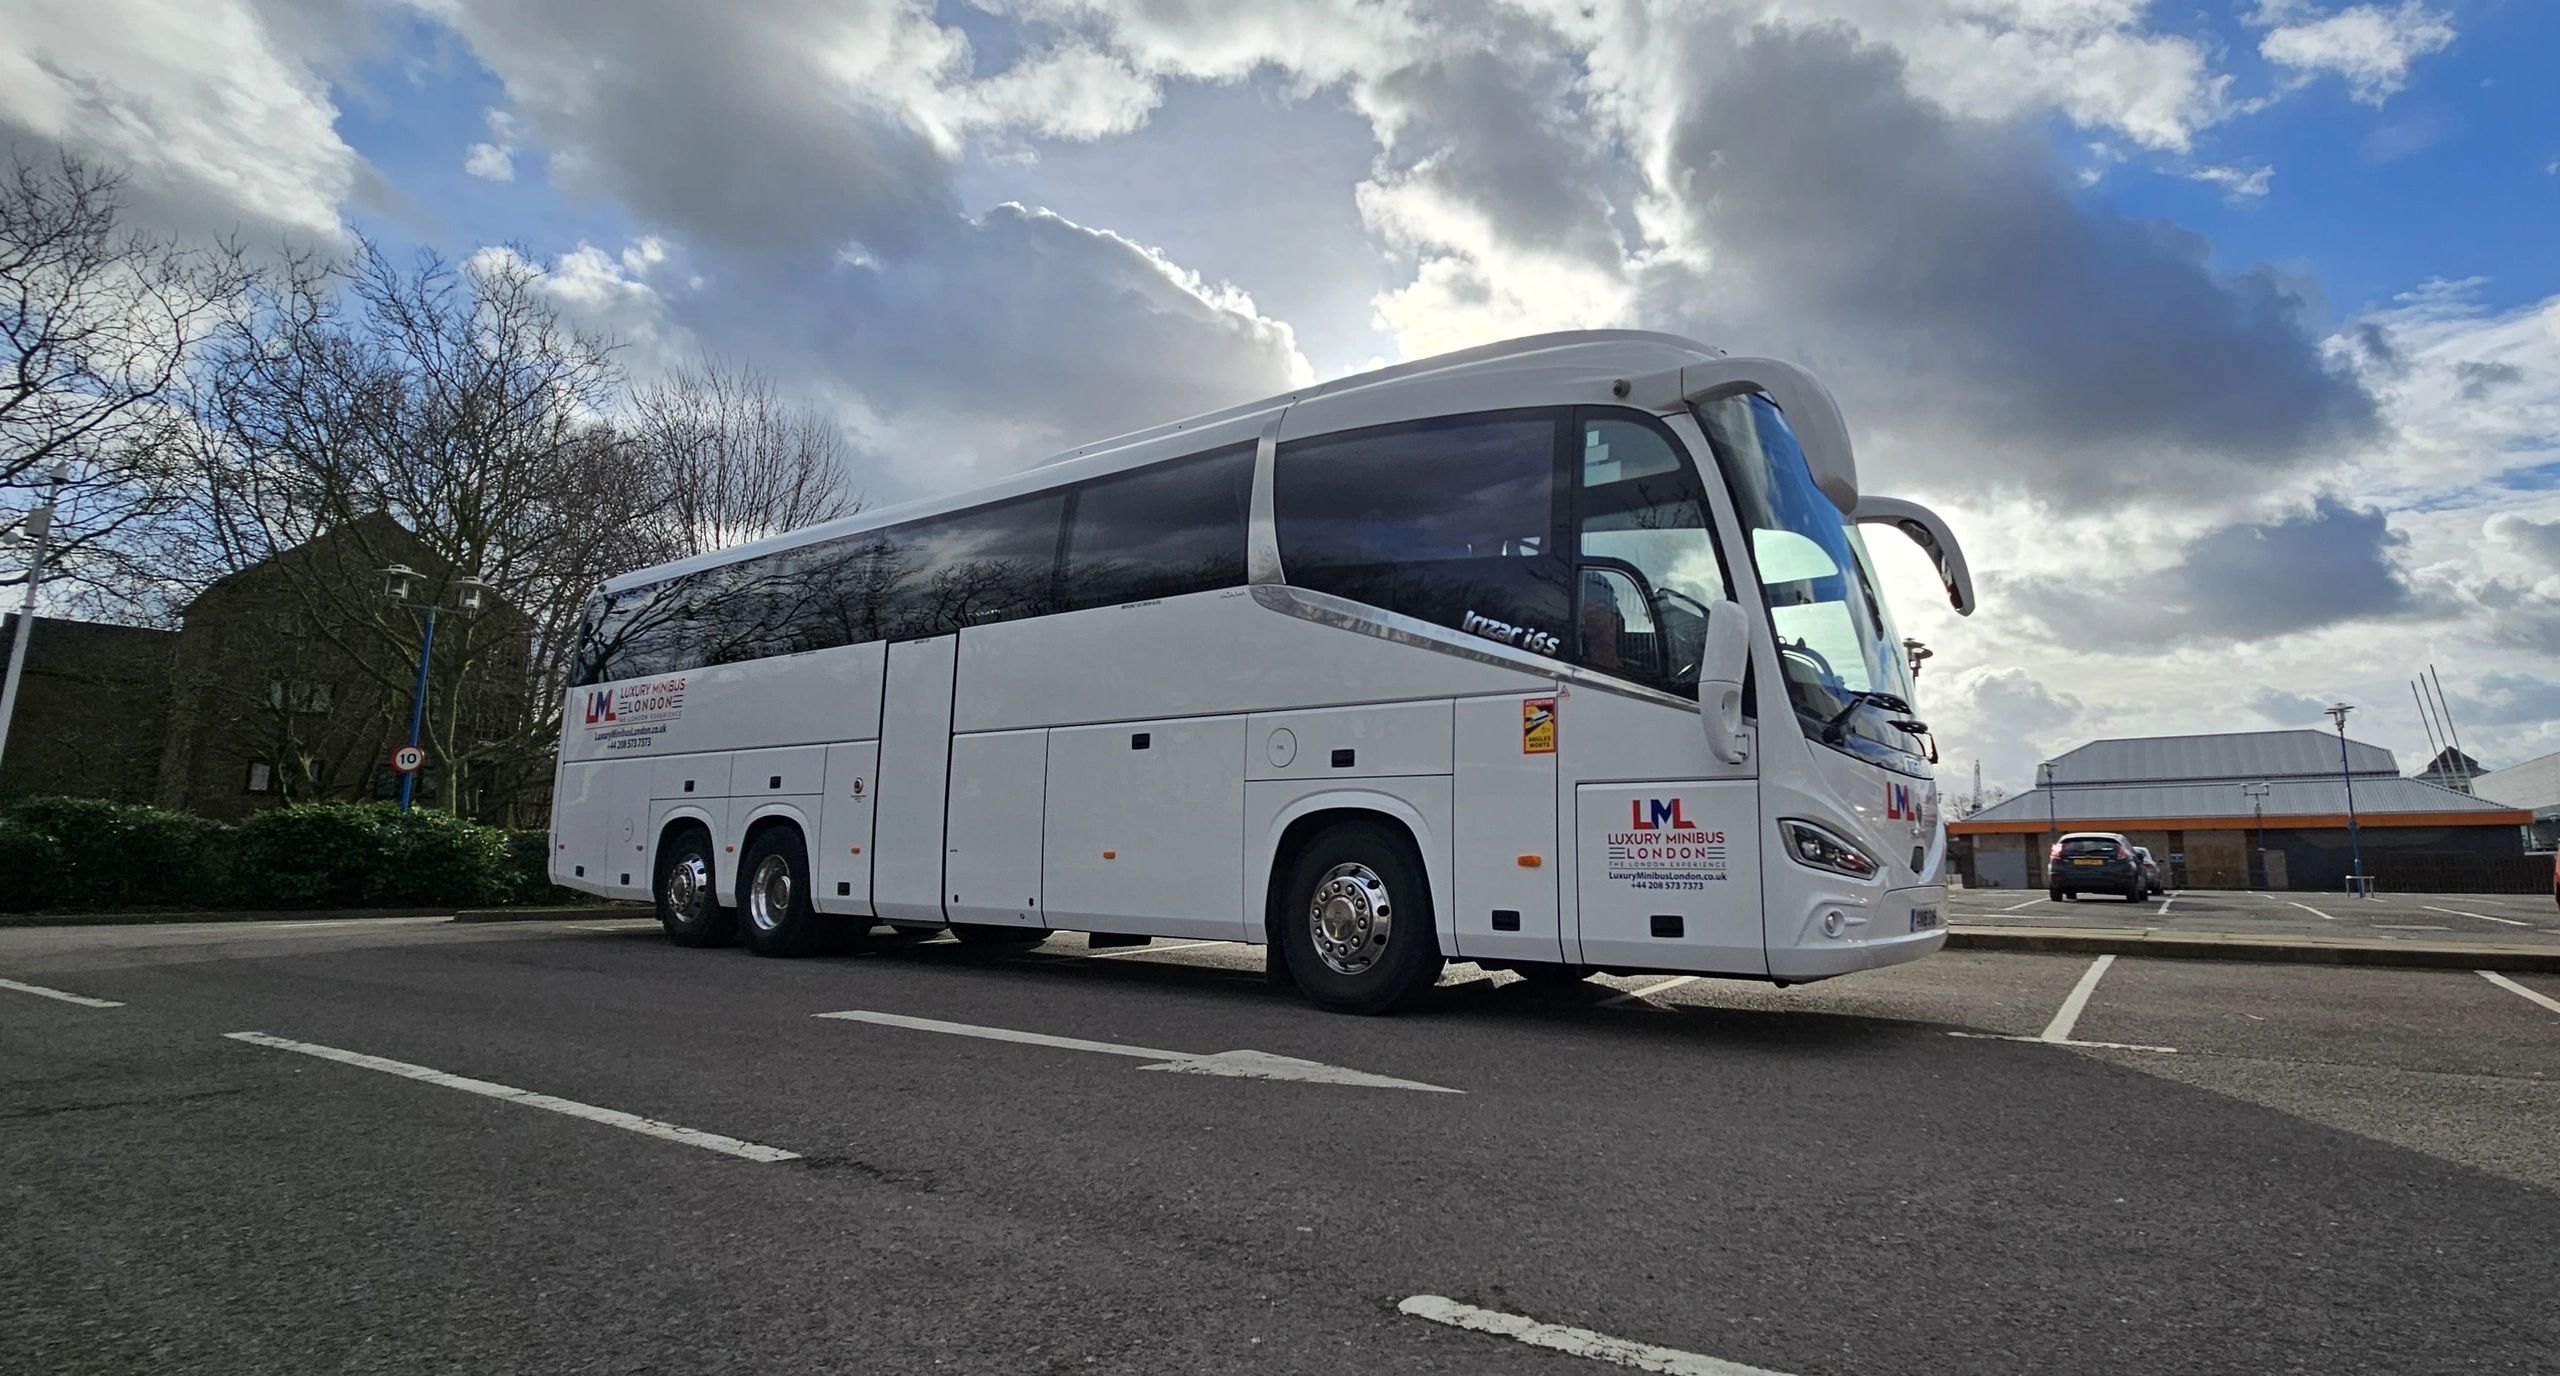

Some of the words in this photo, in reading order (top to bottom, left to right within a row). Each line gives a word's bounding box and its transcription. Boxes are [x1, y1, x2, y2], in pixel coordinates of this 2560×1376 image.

[1462, 610, 1523, 643] Irizar
[1522, 628, 1560, 656] i6s
[620, 683, 651, 699] LUXURY
[652, 678, 685, 694] MINIBUS
[585, 689, 616, 724] LML
[628, 696, 672, 713] LONDON
[400, 753, 417, 765] 10
[1886, 781, 1915, 821] LML
[1632, 798, 1696, 830] LML
[1608, 833, 1661, 845] LUXURY
[1666, 831, 1725, 844] MINIBUS
[1627, 847, 1706, 860] LONDON
[1609, 871, 1727, 881] LuxuryMinibusLondon.co.uk
[1631, 881, 1646, 889] +44
[1648, 881, 1663, 890] 208
[1665, 882, 1680, 890] 573
[1682, 882, 1704, 890] 7373
